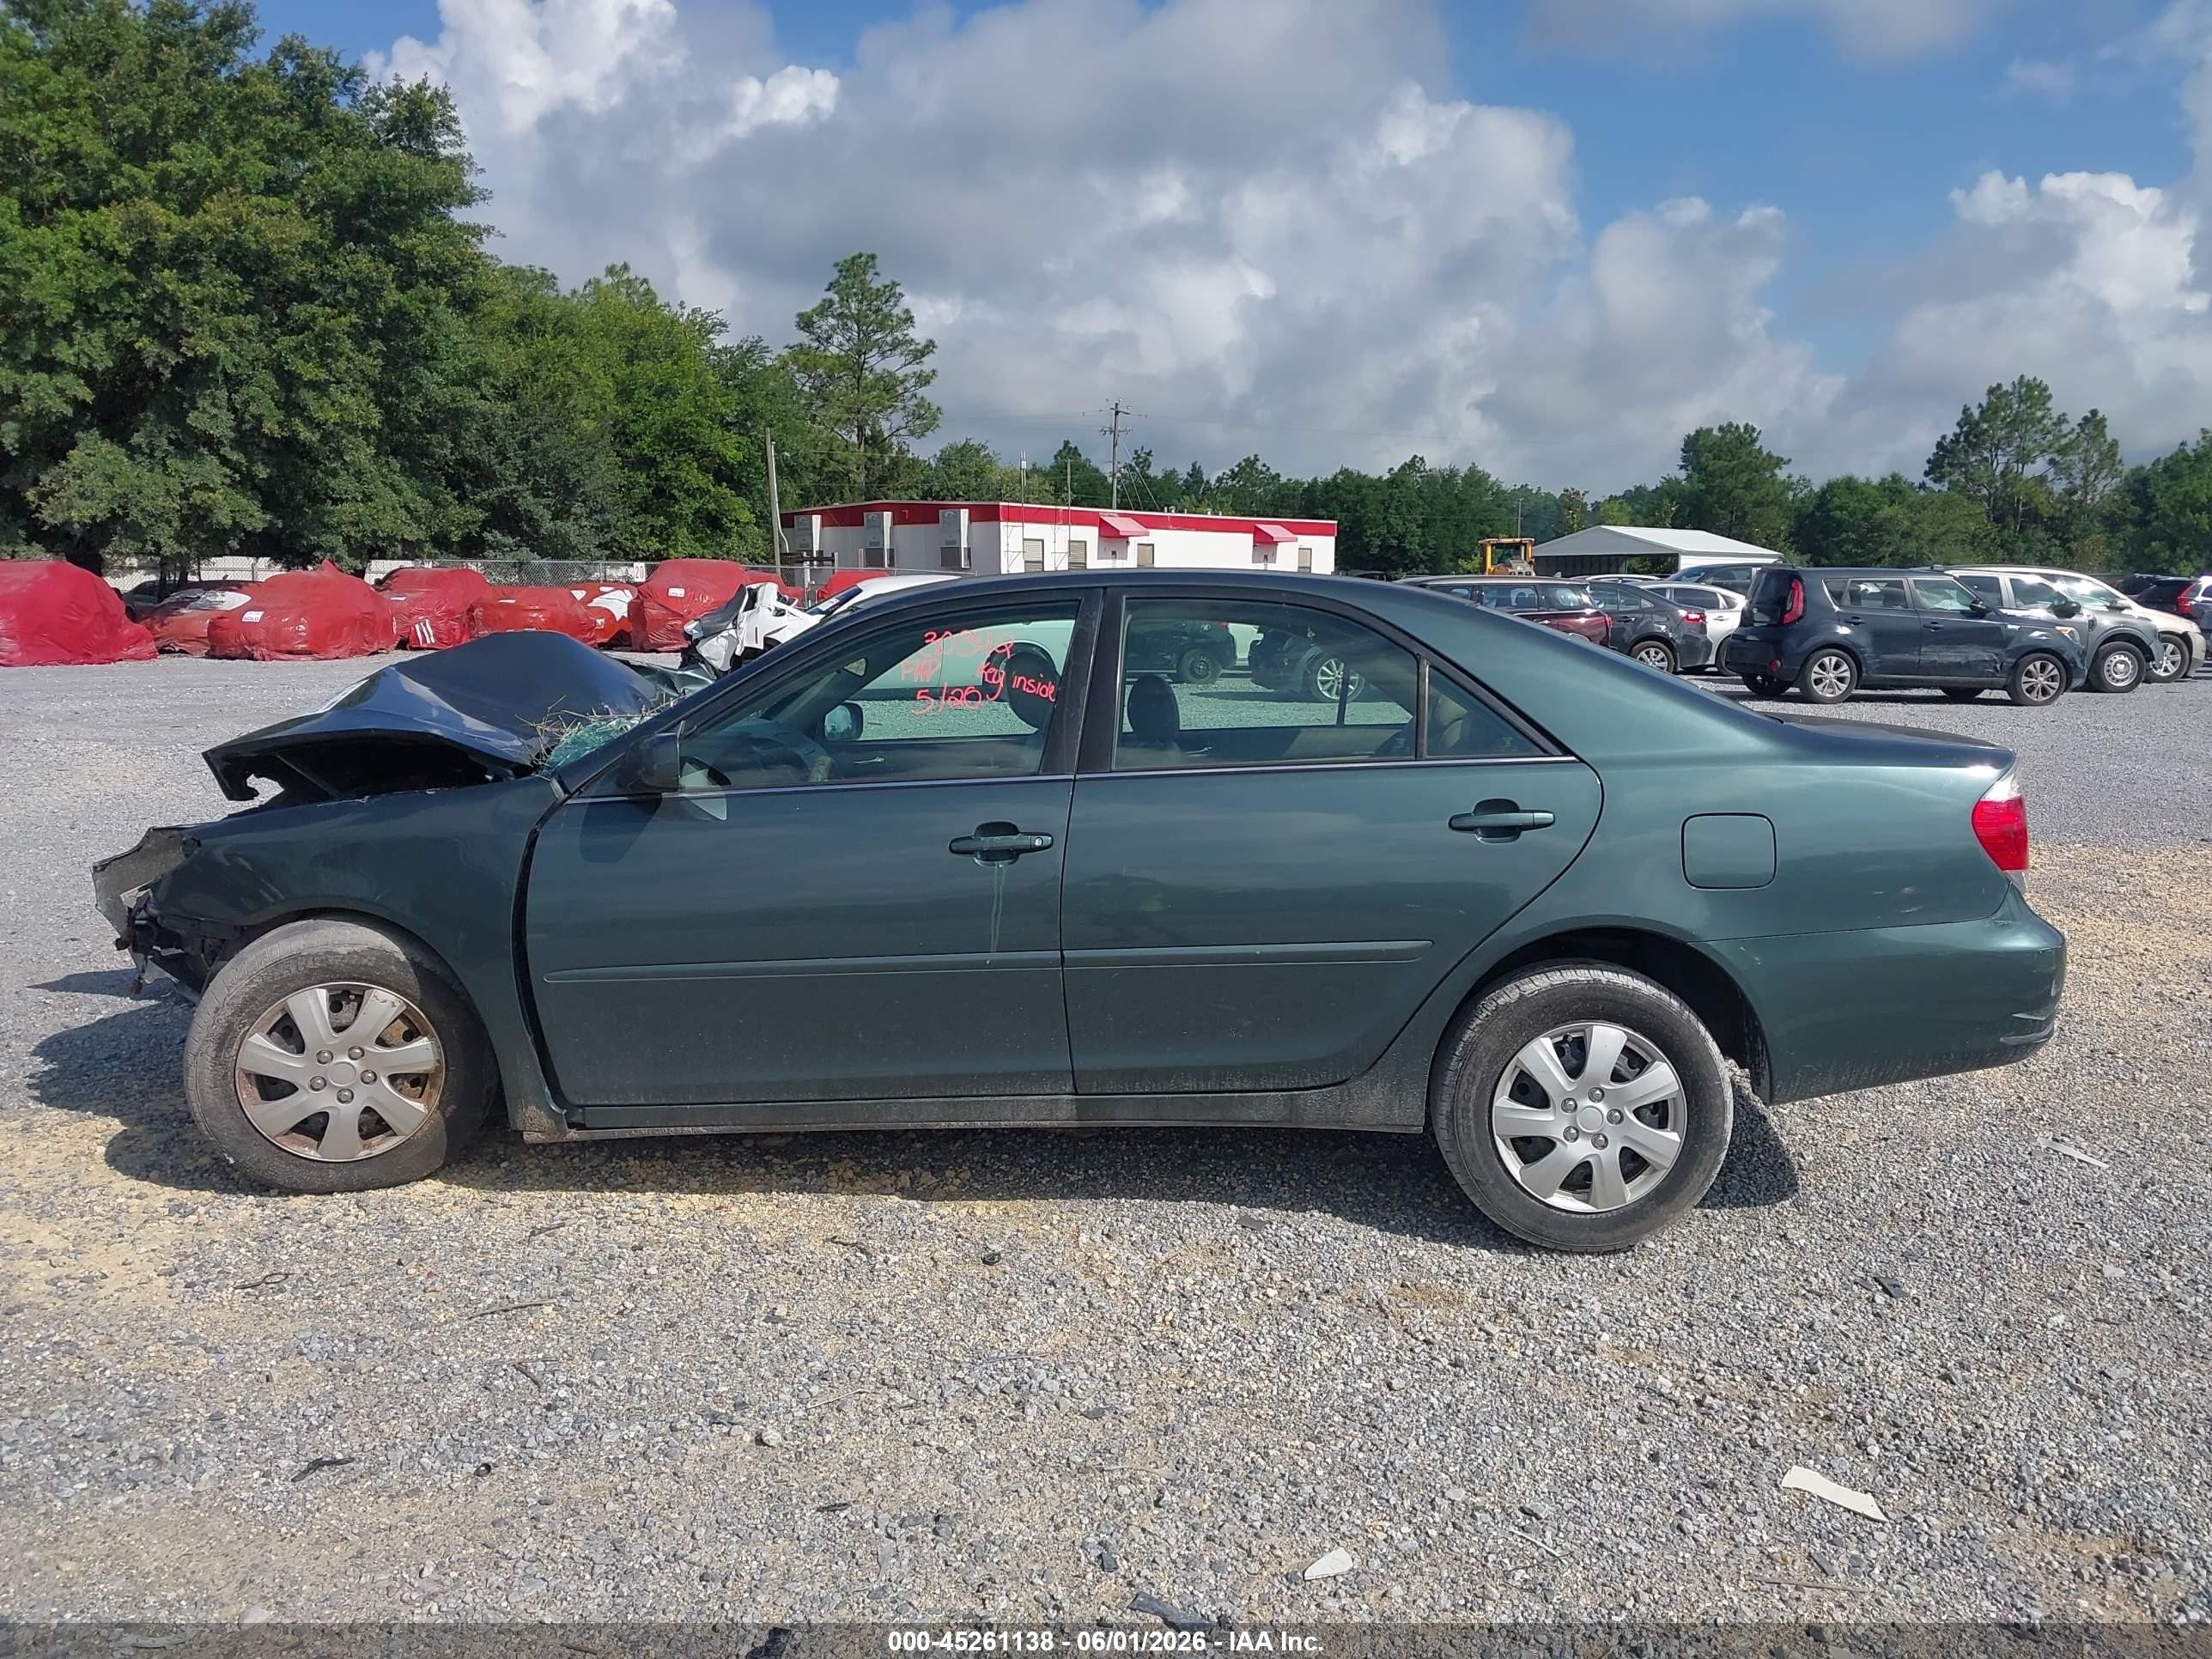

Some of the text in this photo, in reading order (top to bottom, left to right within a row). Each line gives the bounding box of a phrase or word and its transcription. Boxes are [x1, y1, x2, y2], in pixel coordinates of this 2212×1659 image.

[635, 565, 644, 579] 20
[911, 681, 982, 714] 5/20
[1012, 673, 1056, 702] inside
